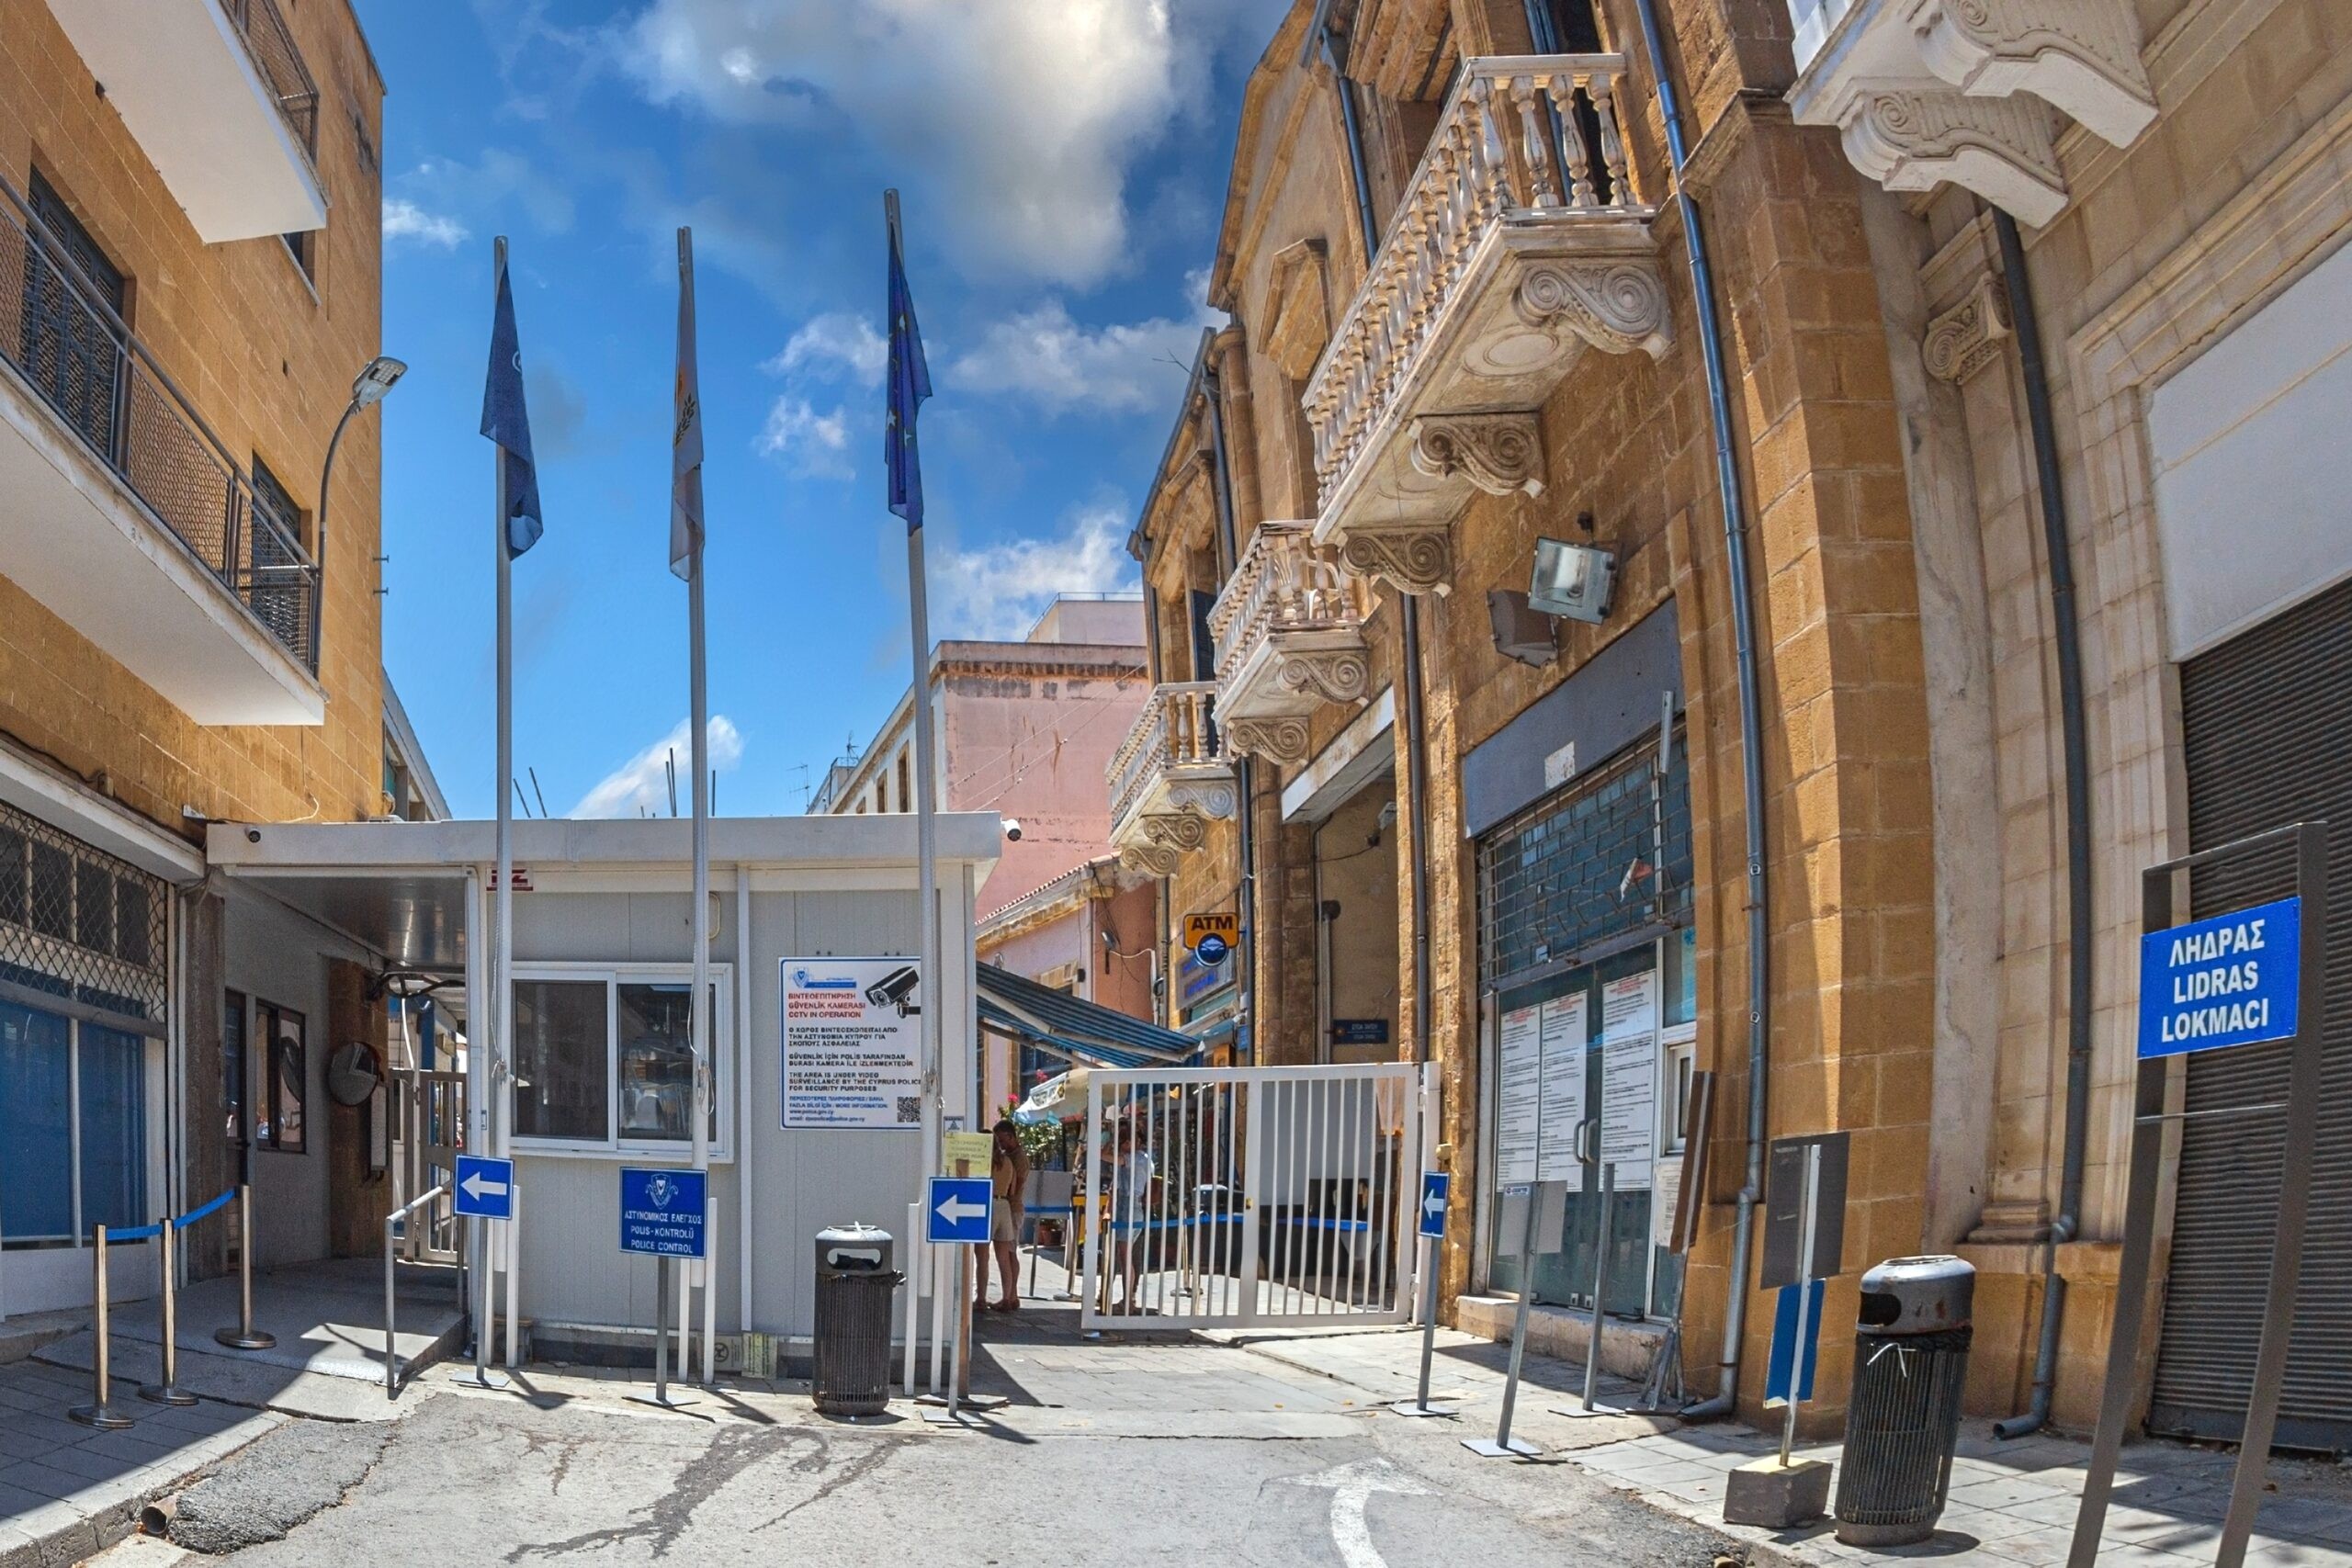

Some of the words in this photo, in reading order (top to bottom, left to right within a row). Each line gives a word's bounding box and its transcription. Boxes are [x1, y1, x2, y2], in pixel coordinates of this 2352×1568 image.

[1192, 916, 1233, 931] ATM
[2169, 919, 2265, 968] ΛΗΔΡΑΣ
[2174, 961, 2258, 1004] LIDRAS
[828, 1001, 865, 1009] KAMERASI
[2161, 998, 2268, 1042] LOKMACI
[625, 1210, 668, 1222] ΑΣΤΥΝΟΜΙΚΟΣ
[671, 1214, 702, 1224] ΕΛΕΓΧΟΣ
[631, 1240, 655, 1249] POLICE
[658, 1242, 693, 1253] CONTROL
